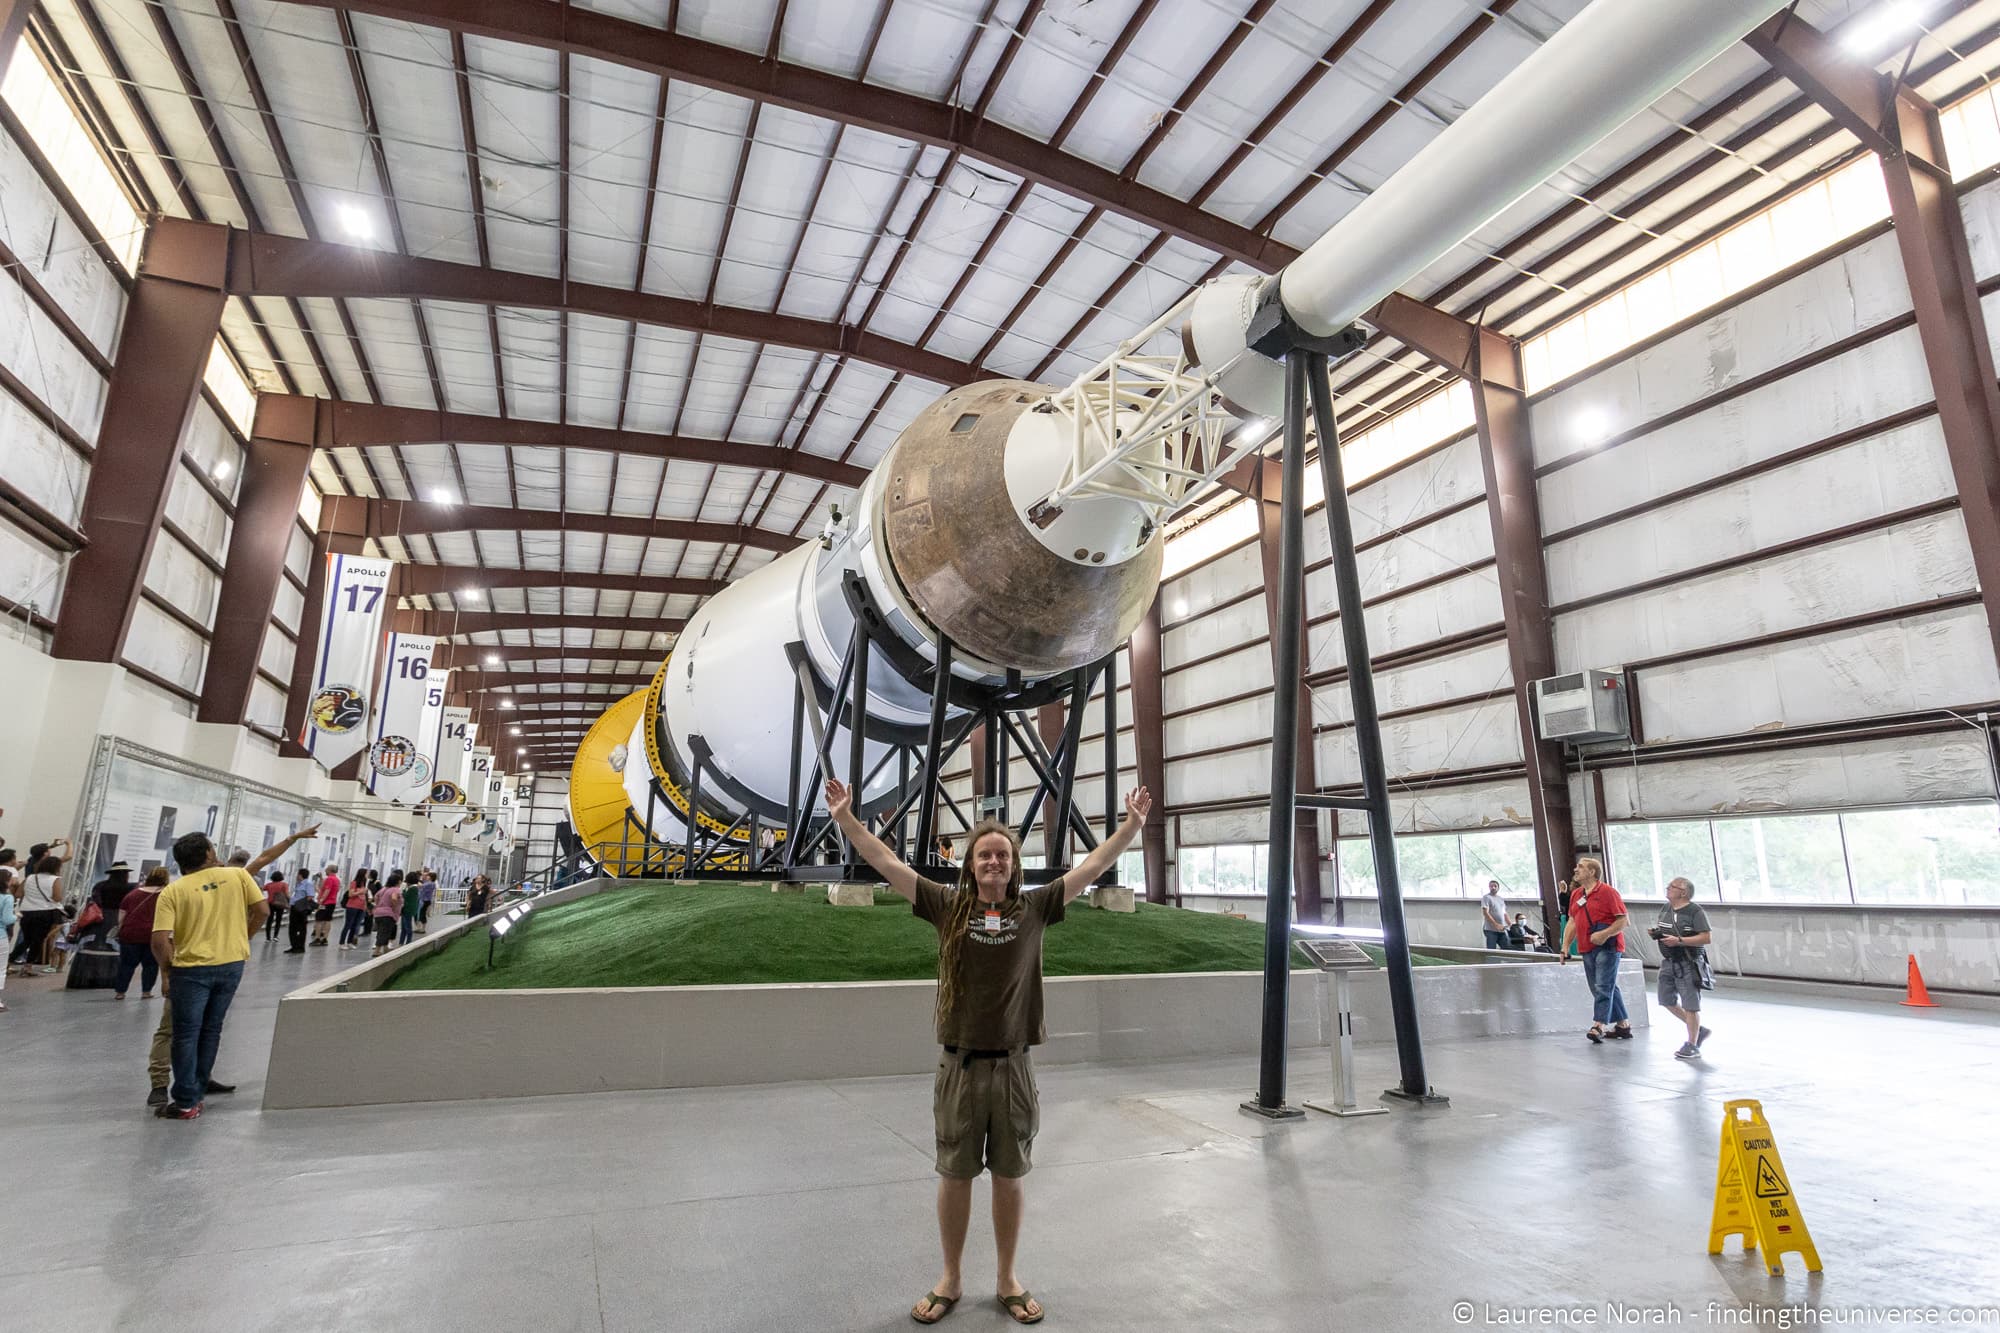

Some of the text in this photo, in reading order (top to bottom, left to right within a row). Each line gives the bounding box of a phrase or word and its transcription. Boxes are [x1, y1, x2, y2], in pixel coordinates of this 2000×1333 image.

[347, 567, 387, 578] APOLLO
[344, 584, 384, 614] 17
[399, 642, 432, 651] APOLLO
[397, 656, 428, 680] 16
[424, 688, 442, 707] 5
[445, 722, 466, 740] 14
[463, 737, 473, 752] 3
[471, 758, 487, 772] 12
[502, 796, 509, 806] 8
[969, 931, 1017, 944] ORIGINAL
[1743, 1138, 1772, 1151] CAUTION
[1769, 1199, 1783, 1208] WET
[1769, 1208, 1790, 1218] FLOOR
